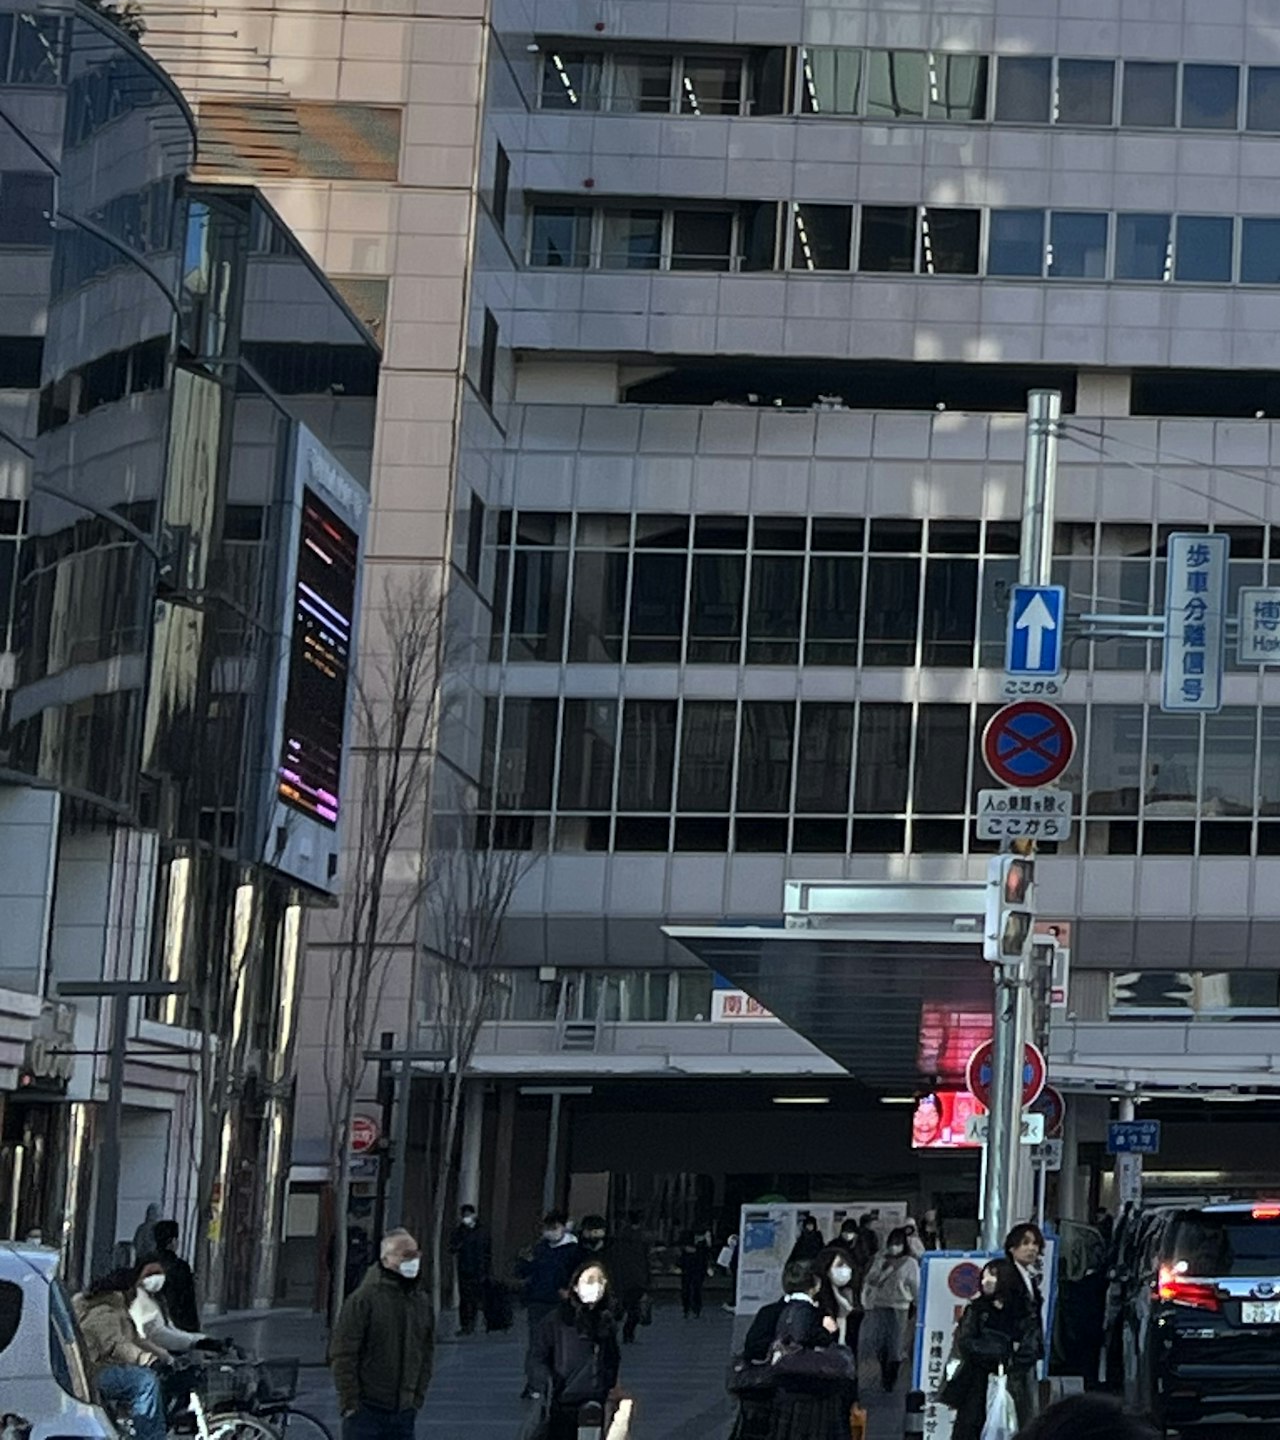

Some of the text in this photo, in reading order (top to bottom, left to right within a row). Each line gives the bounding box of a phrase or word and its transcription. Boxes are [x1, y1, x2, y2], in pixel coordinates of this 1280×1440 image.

[1180, 544, 1211, 703] 歩車分離信号
[1005, 680, 1059, 695] ここから
[988, 818, 1059, 835] ここから
